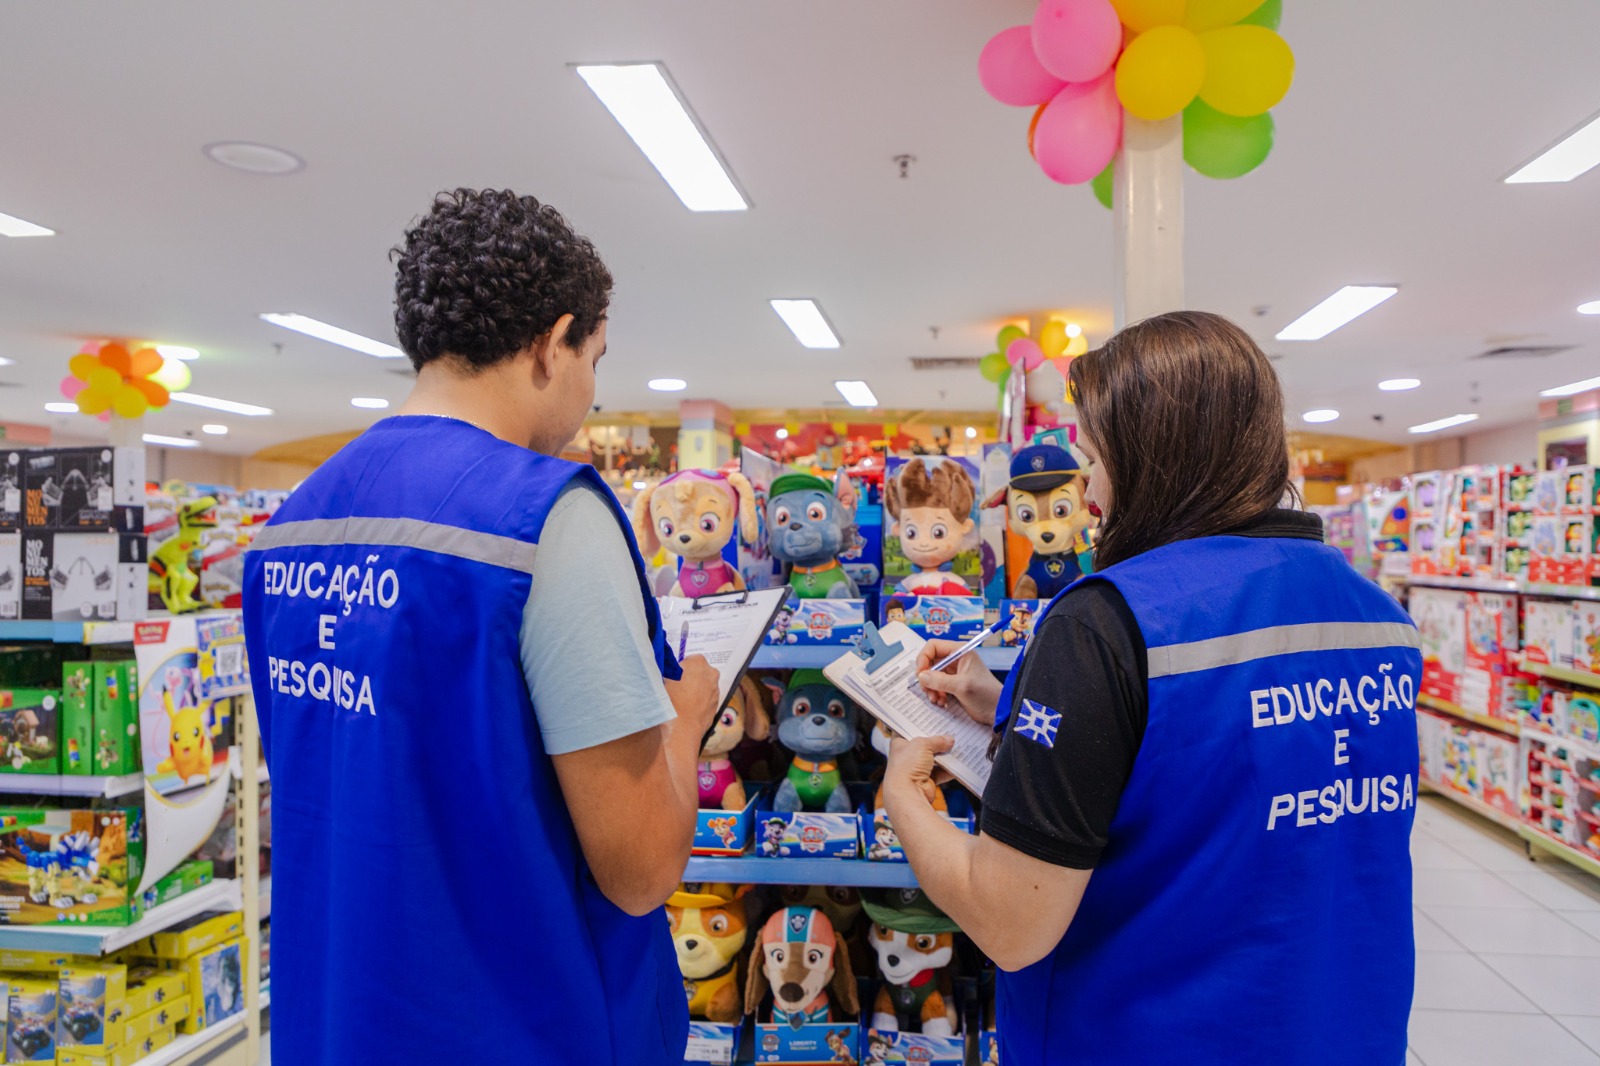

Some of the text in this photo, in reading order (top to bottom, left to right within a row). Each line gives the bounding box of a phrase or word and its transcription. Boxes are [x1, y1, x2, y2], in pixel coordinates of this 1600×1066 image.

[26, 539, 44, 550] MO
[26, 567, 46, 577] TOS
[264, 554, 400, 617] EDUCAÇÃO
[319, 614, 337, 650] E
[268, 656, 377, 716] PESQUISA
[1250, 662, 1414, 728] EDUCAÇÃO
[1334, 729, 1350, 766] E
[1266, 773, 1414, 831] PESQUISA
